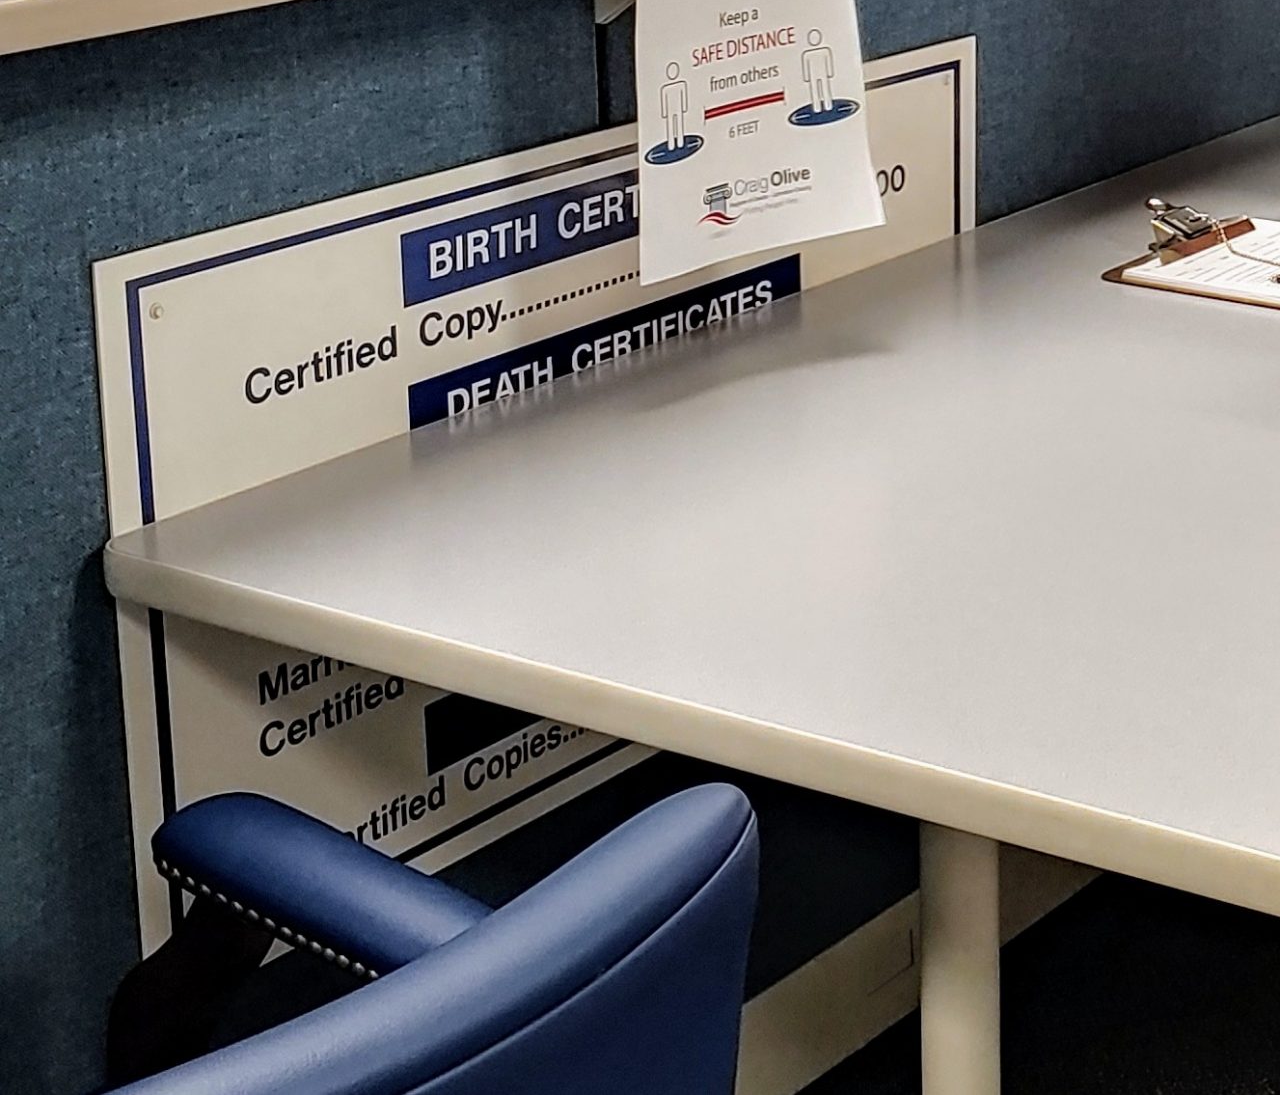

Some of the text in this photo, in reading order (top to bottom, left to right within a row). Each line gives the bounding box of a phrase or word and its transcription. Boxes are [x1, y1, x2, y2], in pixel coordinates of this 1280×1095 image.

[719, 8, 758, 27] Keep a
[692, 27, 796, 67] SAFE DISTANCE
[710, 63, 779, 92] from others
[729, 120, 759, 138] 6 FEET
[735, 169, 810, 195] Craig Olive
[429, 214, 537, 280] BIRTH
[245, 325, 397, 404] Certified
[447, 280, 773, 417] DEATH CERTIFICATES
[259, 675, 404, 757] Certified
[343, 775, 446, 844] rtified
